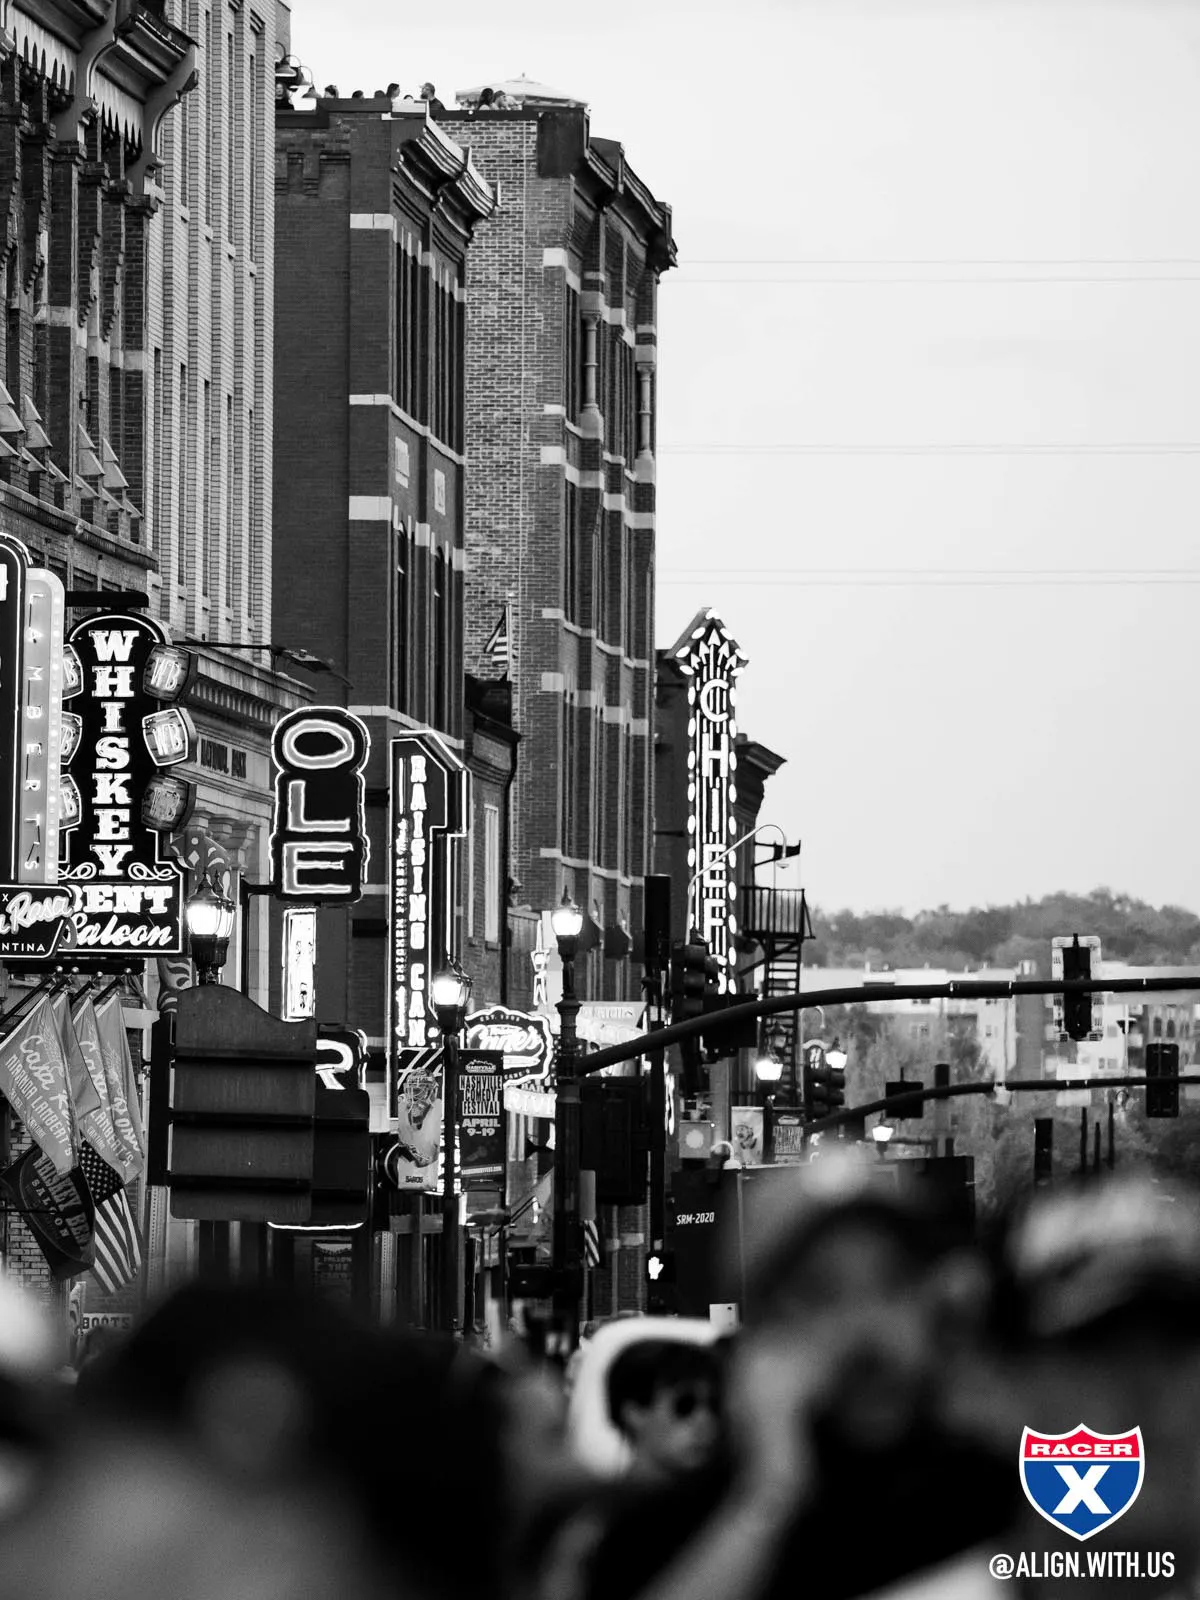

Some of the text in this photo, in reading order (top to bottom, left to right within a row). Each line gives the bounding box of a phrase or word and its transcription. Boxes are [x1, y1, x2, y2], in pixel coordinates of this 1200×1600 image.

[24, 593, 44, 870] LAMBERT'S
[88, 630, 140, 876] WHISKEY
[282, 718, 356, 895] OLE
[6, 891, 73, 935] Rosa
[409, 755, 427, 1046] RAISING CAN
[20, 1034, 55, 1091] Casa
[460, 1076, 502, 1090] NASHVILLE
[5, 1054, 72, 1157] MIRANDA LAMBERT'S
[462, 1101, 500, 1115] FESTIVAL
[464, 1089, 497, 1101] COMEDY
[462, 1118, 501, 1127] APRIL
[676, 1212, 715, 1225] SRM-2020
[82, 1315, 131, 1330] BOOTS
